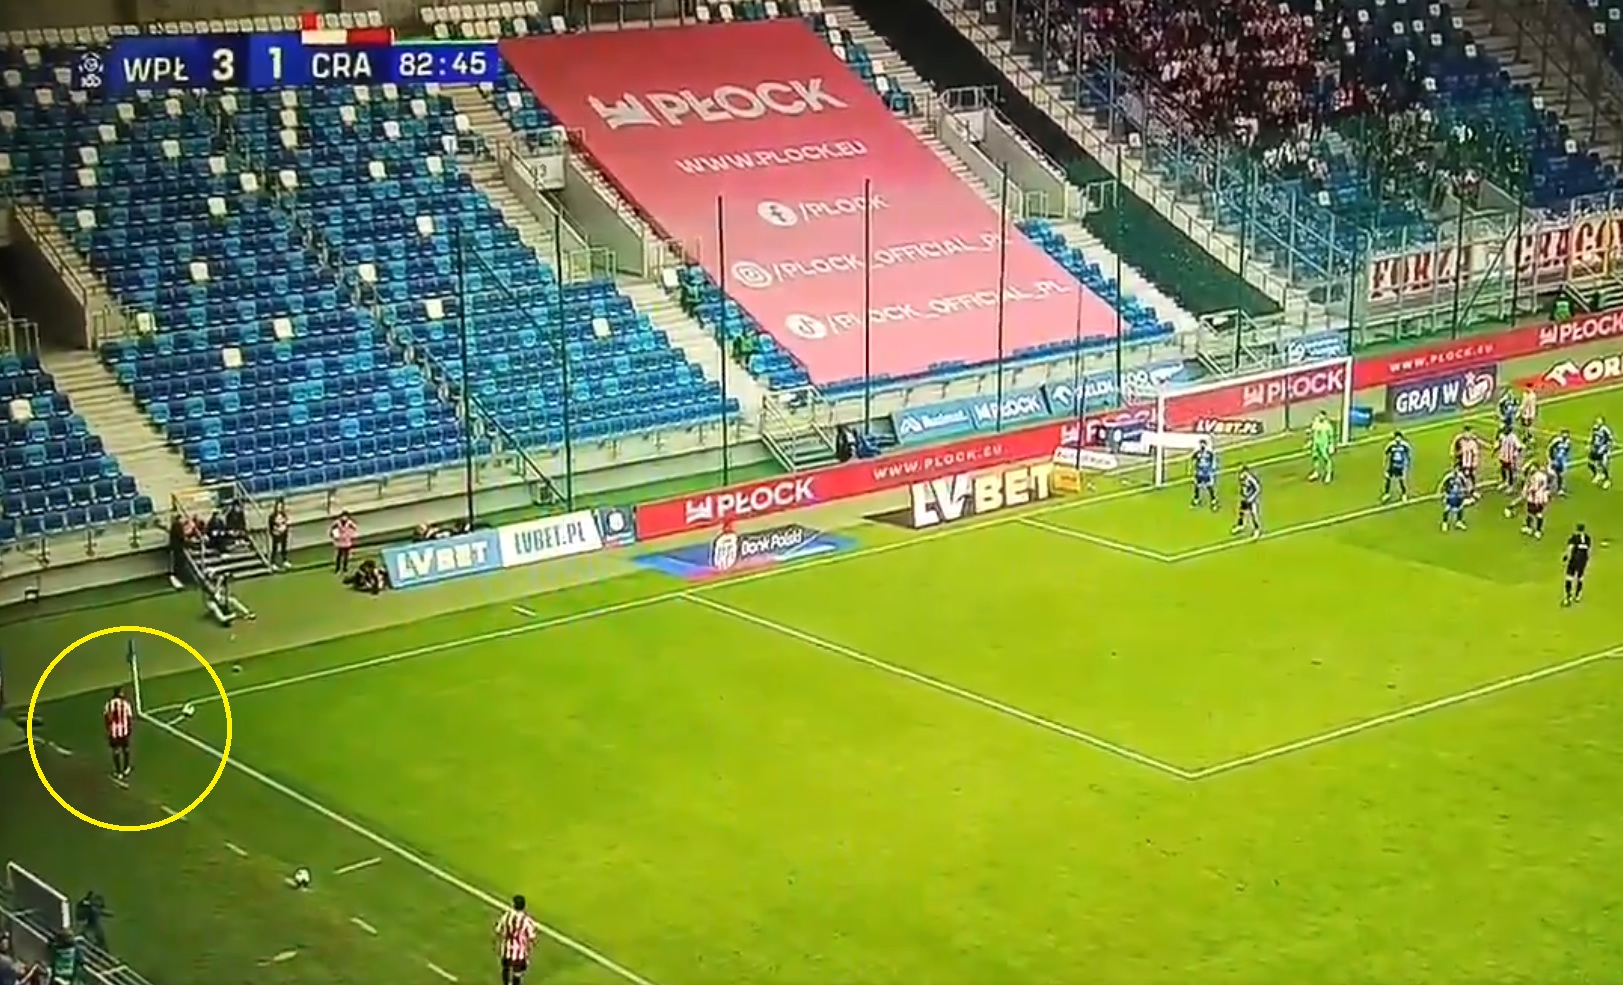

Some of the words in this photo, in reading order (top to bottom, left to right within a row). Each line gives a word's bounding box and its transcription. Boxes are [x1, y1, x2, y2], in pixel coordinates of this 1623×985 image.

[646, 78, 849, 126] PŁOCK
[676, 139, 868, 174] WWW.PLOCK.EU
[1395, 385, 1438, 414] GRAJ
[1442, 381, 1460, 404] W
[872, 445, 1004, 481] WWW.PLOCK.EU
[717, 476, 817, 518] PŁOCK
[911, 462, 1053, 529] LVBET
